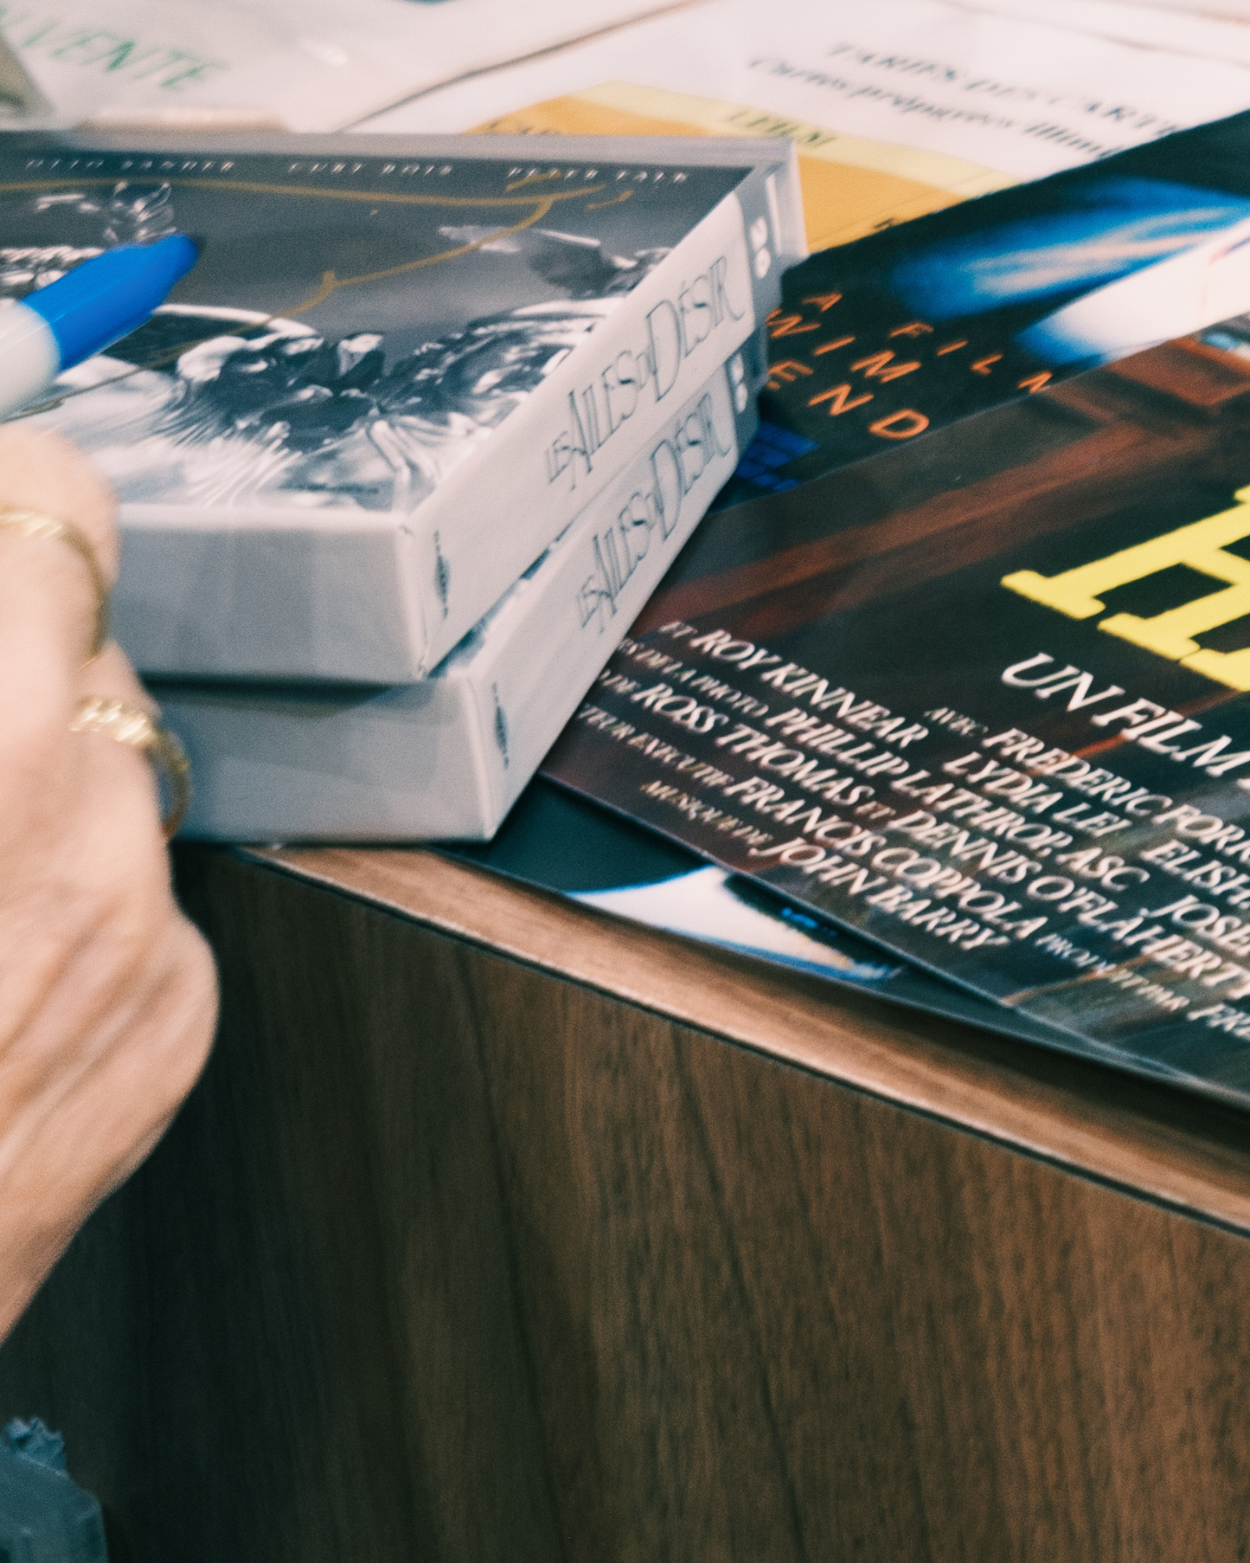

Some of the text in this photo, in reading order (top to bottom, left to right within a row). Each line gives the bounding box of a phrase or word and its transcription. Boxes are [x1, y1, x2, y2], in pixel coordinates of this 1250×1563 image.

[765, 307, 922, 384] WIM
[689, 628, 783, 671] ROY
[760, 661, 930, 749] KINNEAR
[1000, 652, 1250, 778] UN FILM
[630, 682, 729, 734] ROSS
[715, 722, 876, 806] THOMAS
[887, 809, 1043, 884] DENNIS
[763, 707, 910, 778] PHILLIP
[1056, 846, 1150, 892] ASC
[1139, 894, 1250, 957] JOSE
[942, 751, 1250, 911] LYDIA LEI ELISH
[981, 727, 1172, 817] FREDERIC
[723, 775, 888, 857] FRANCIS
[870, 846, 1048, 940] COPPOLA
[748, 837, 888, 896] JOHN
[864, 883, 1010, 951] BARRY
